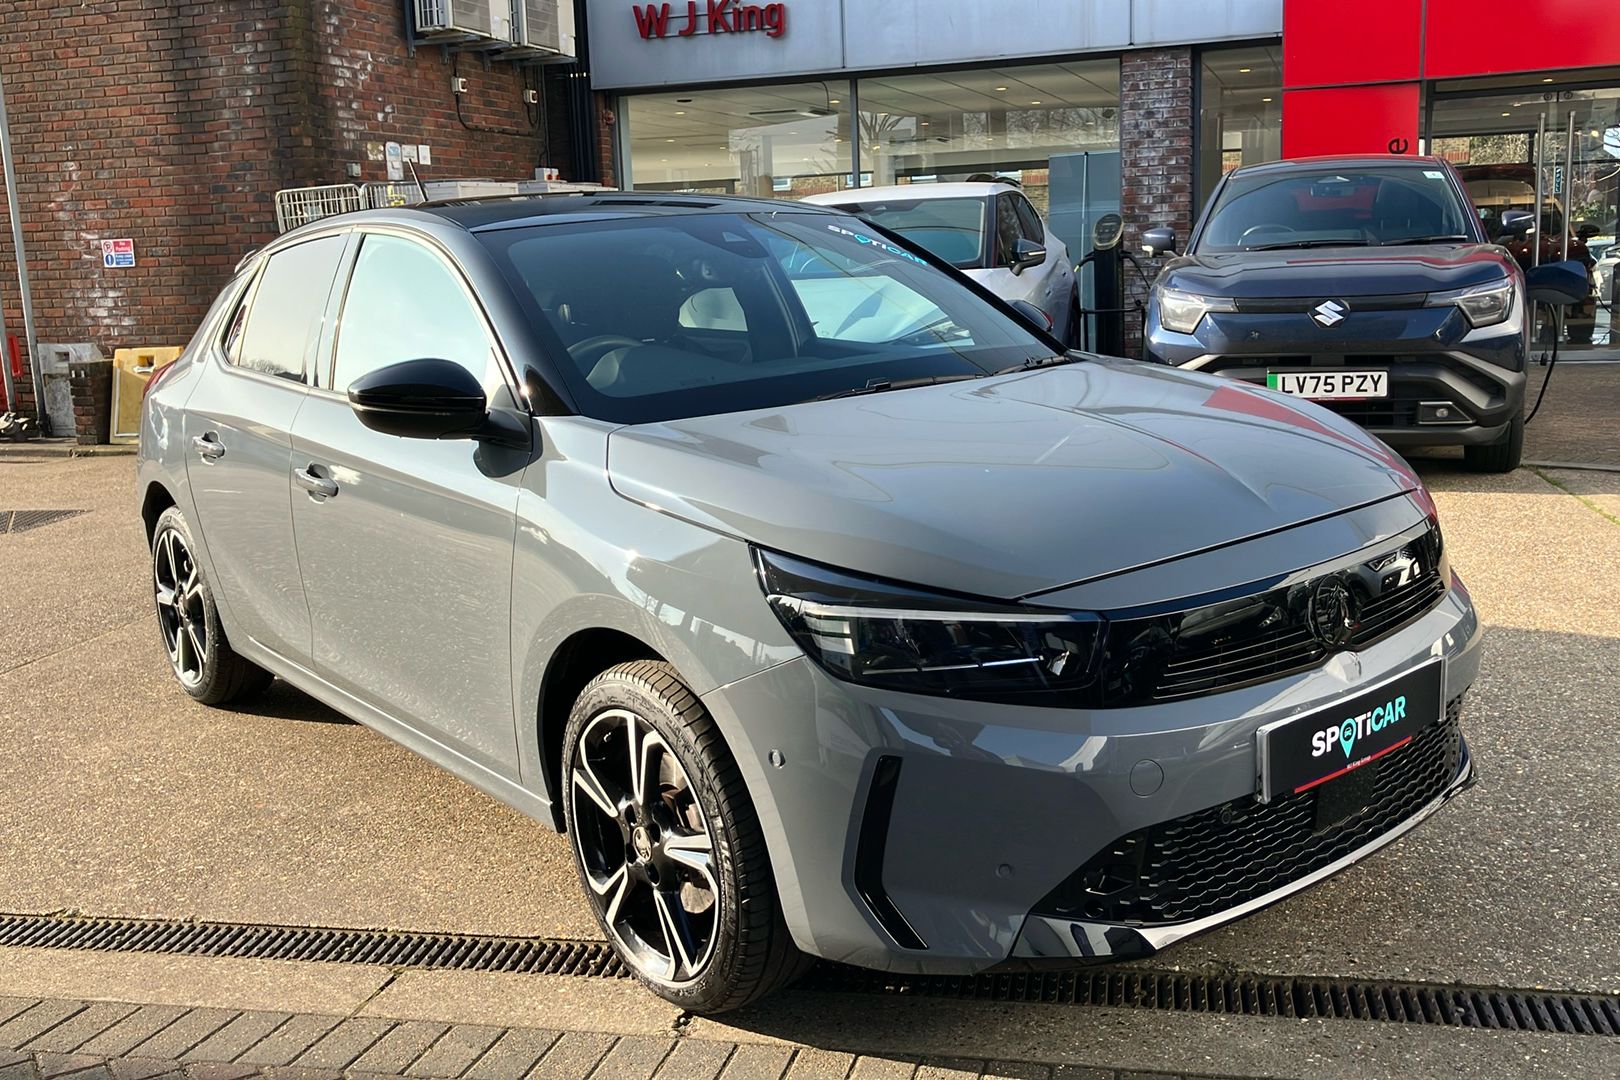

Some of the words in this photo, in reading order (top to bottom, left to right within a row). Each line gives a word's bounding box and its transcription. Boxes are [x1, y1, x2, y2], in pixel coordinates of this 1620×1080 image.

[633, 3, 670, 39] W
[679, 1, 696, 36] J
[708, 0, 785, 38] King
[1281, 376, 1335, 393] LV75
[1341, 374, 1382, 393] PZY
